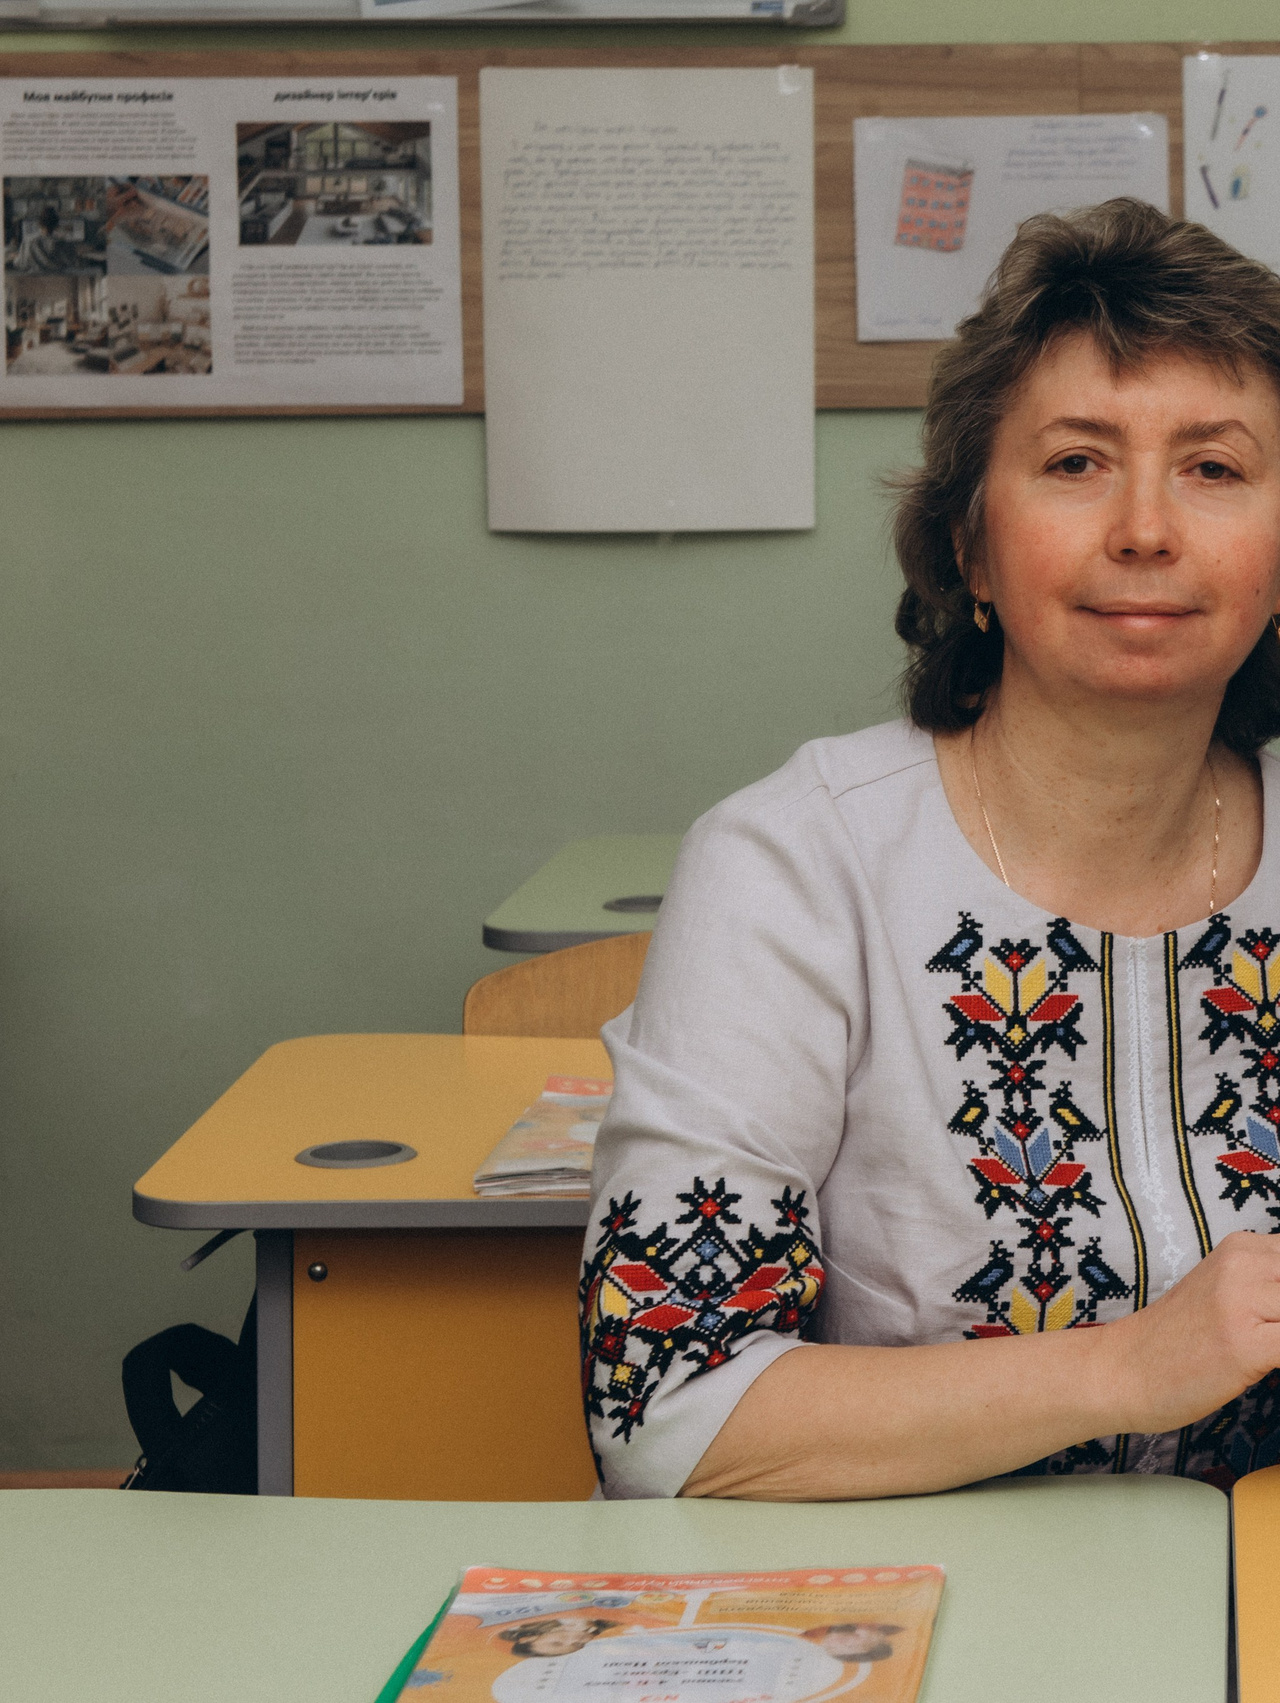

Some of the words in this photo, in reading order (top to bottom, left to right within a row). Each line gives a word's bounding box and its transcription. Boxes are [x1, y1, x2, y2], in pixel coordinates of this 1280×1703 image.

[23, 91, 50, 102] Моя
[54, 89, 113, 104] майбутня
[117, 90, 174, 104] професія
[273, 88, 334, 102] дизайнер
